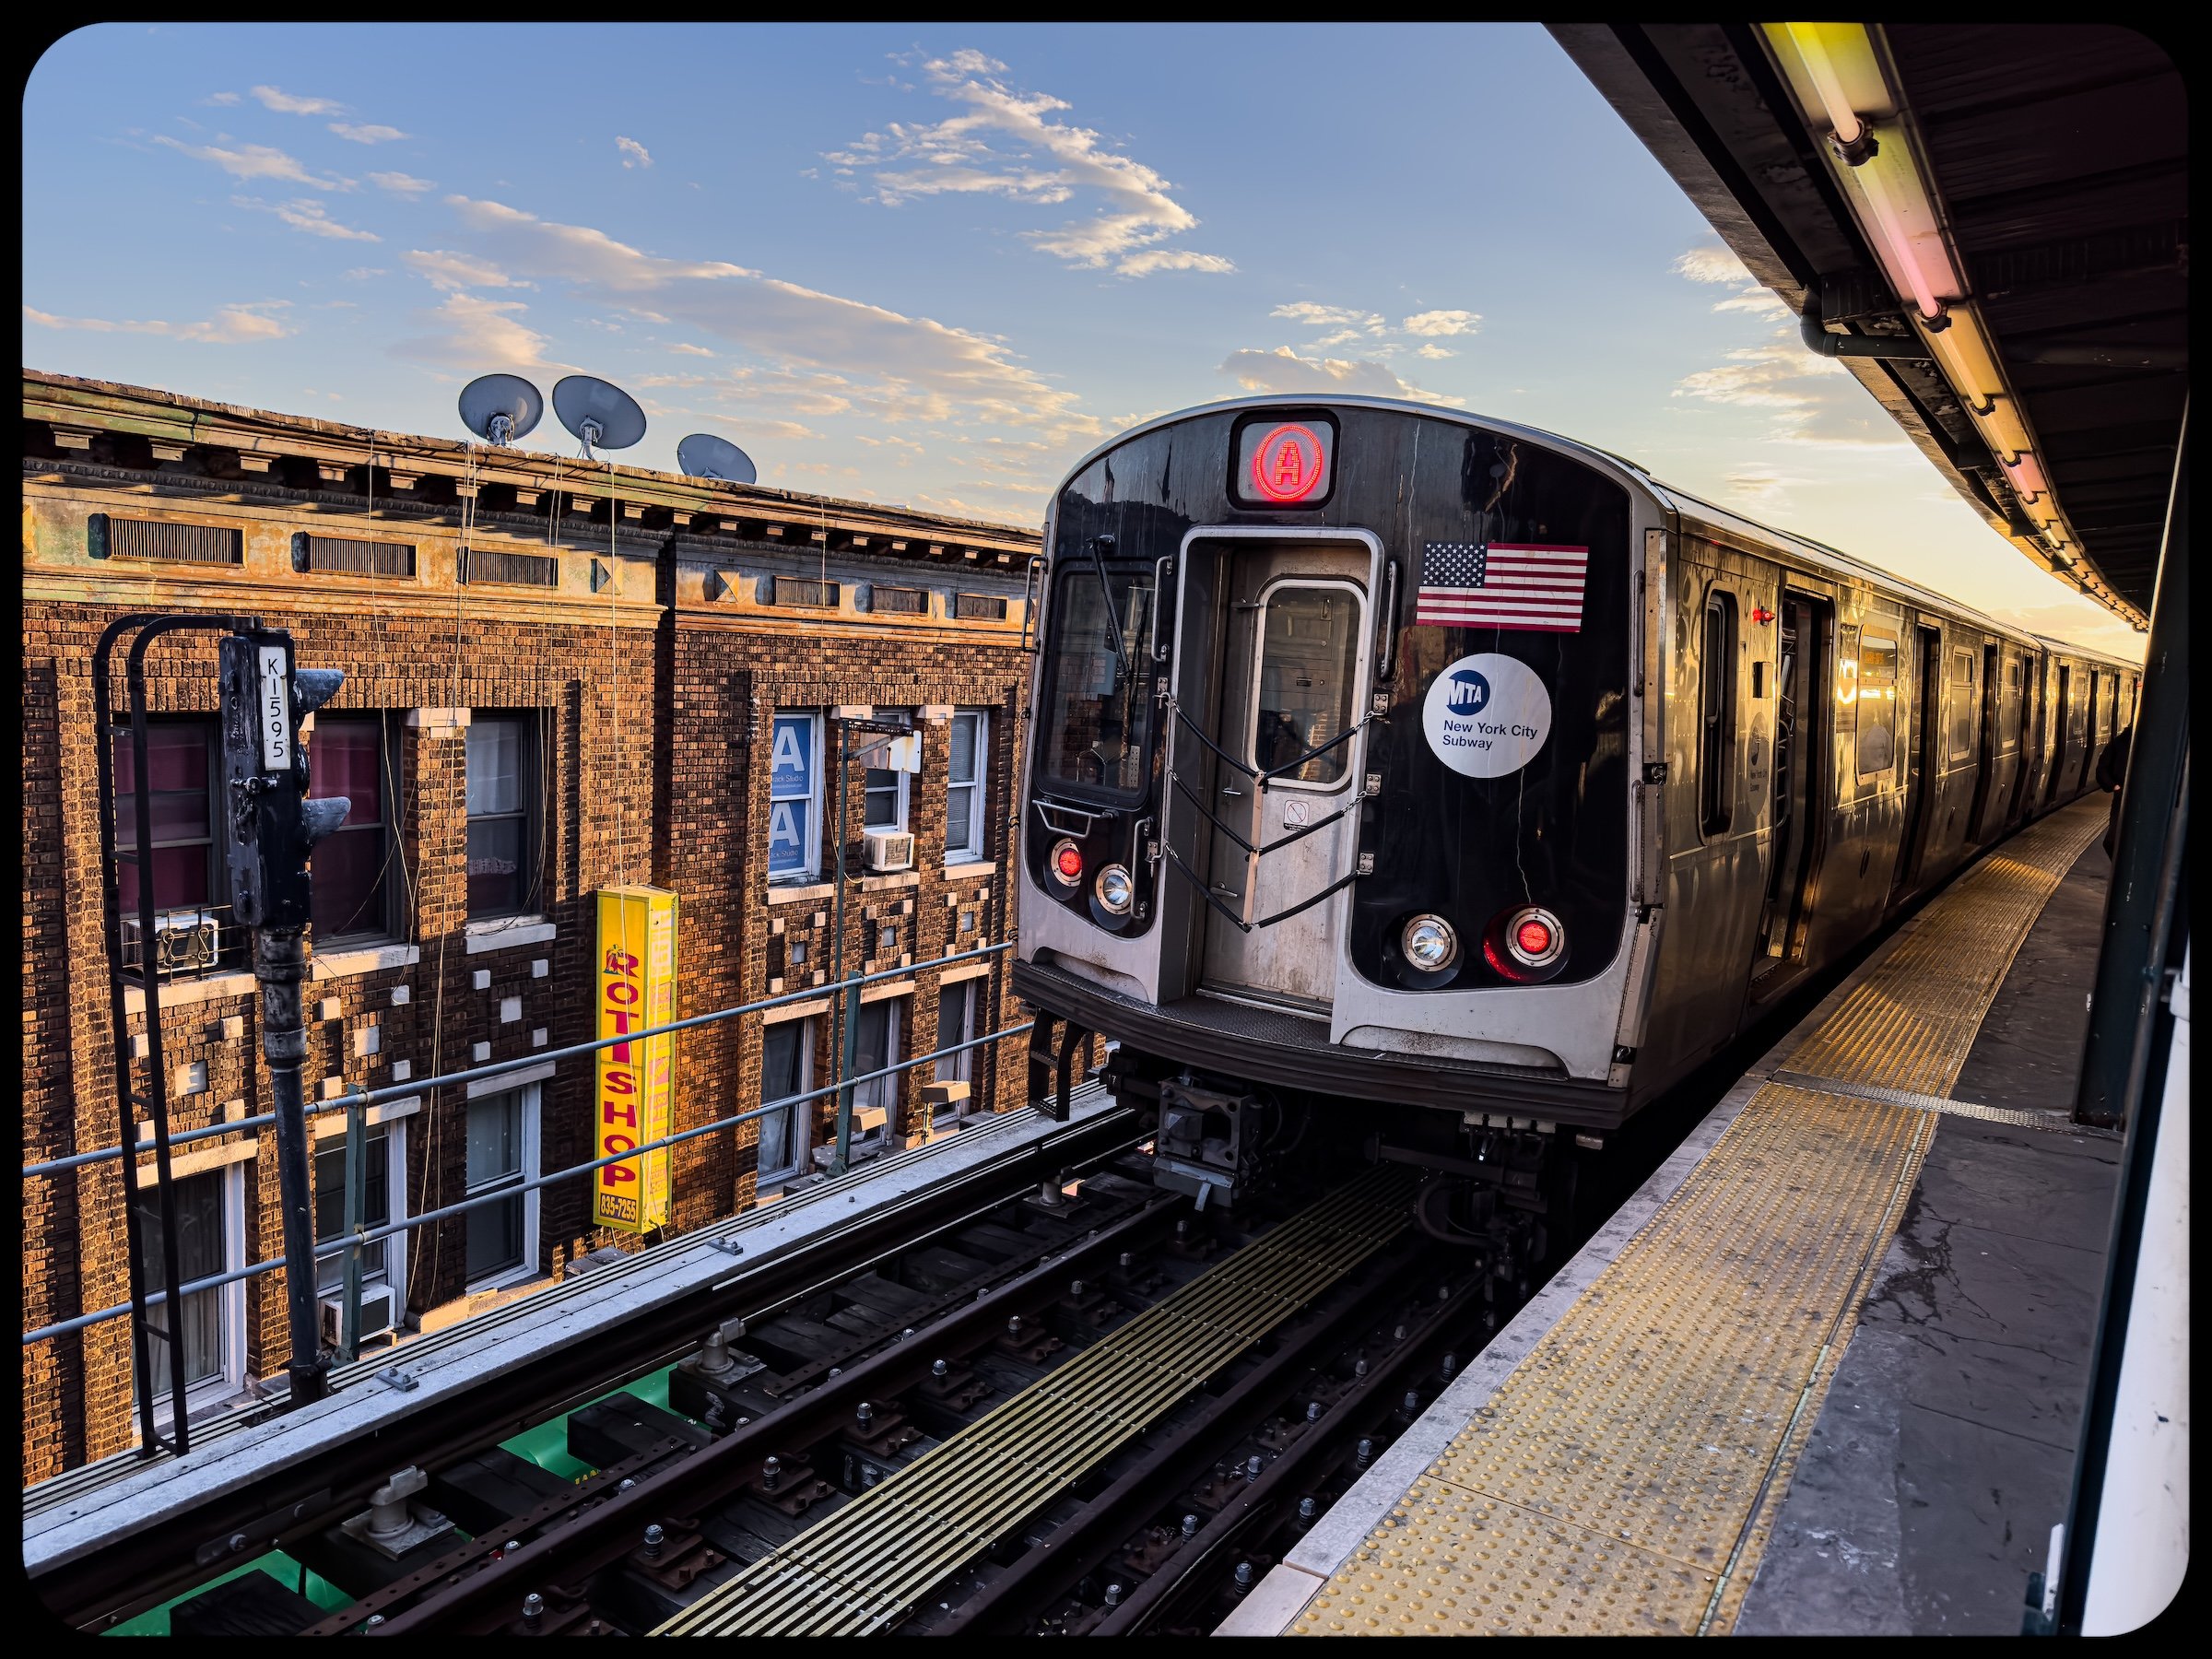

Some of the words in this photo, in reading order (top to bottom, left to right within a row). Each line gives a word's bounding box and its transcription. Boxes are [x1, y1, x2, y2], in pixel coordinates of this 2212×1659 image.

[1275, 440, 1300, 486] A
[1447, 679, 1483, 706] MTA
[1442, 735, 1493, 751] Subway
[1444, 720, 1473, 734] New
[1477, 722, 1507, 736] York
[1511, 724, 1538, 740] City
[604, 1071, 638, 1187] SHOP
[601, 1194, 636, 1221] 835-7255
